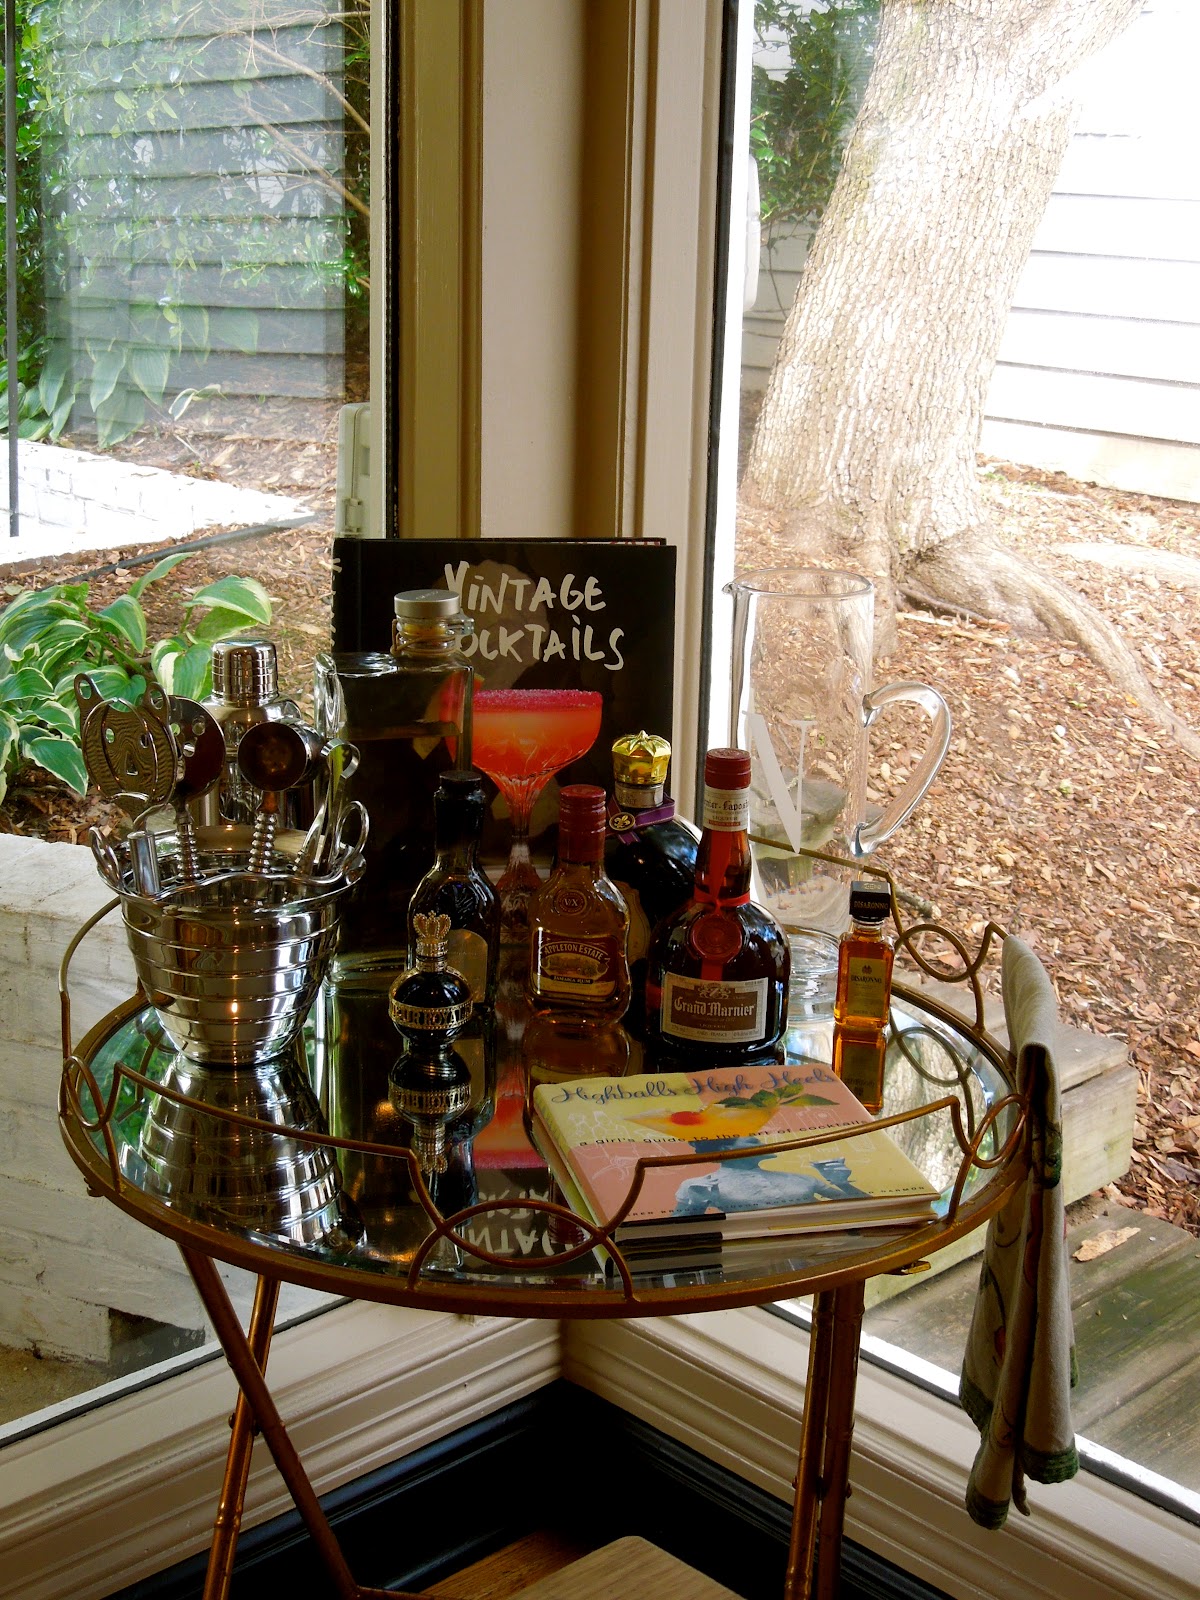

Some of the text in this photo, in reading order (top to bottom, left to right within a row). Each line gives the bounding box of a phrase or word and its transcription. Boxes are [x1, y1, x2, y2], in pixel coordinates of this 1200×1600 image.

[455, 614, 625, 671] OCKTAILS
[544, 943, 604, 960] APPLETON ESTATE
[673, 996, 755, 1018] Grand Marnier
[551, 1080, 677, 1105] Highballs
[684, 1074, 754, 1097] High
[759, 1067, 835, 1091] Heels
[594, 1137, 635, 1145] girl's
[748, 1129, 769, 1137] art
[777, 1127, 792, 1135] of
[798, 1119, 868, 1132] cocktails
